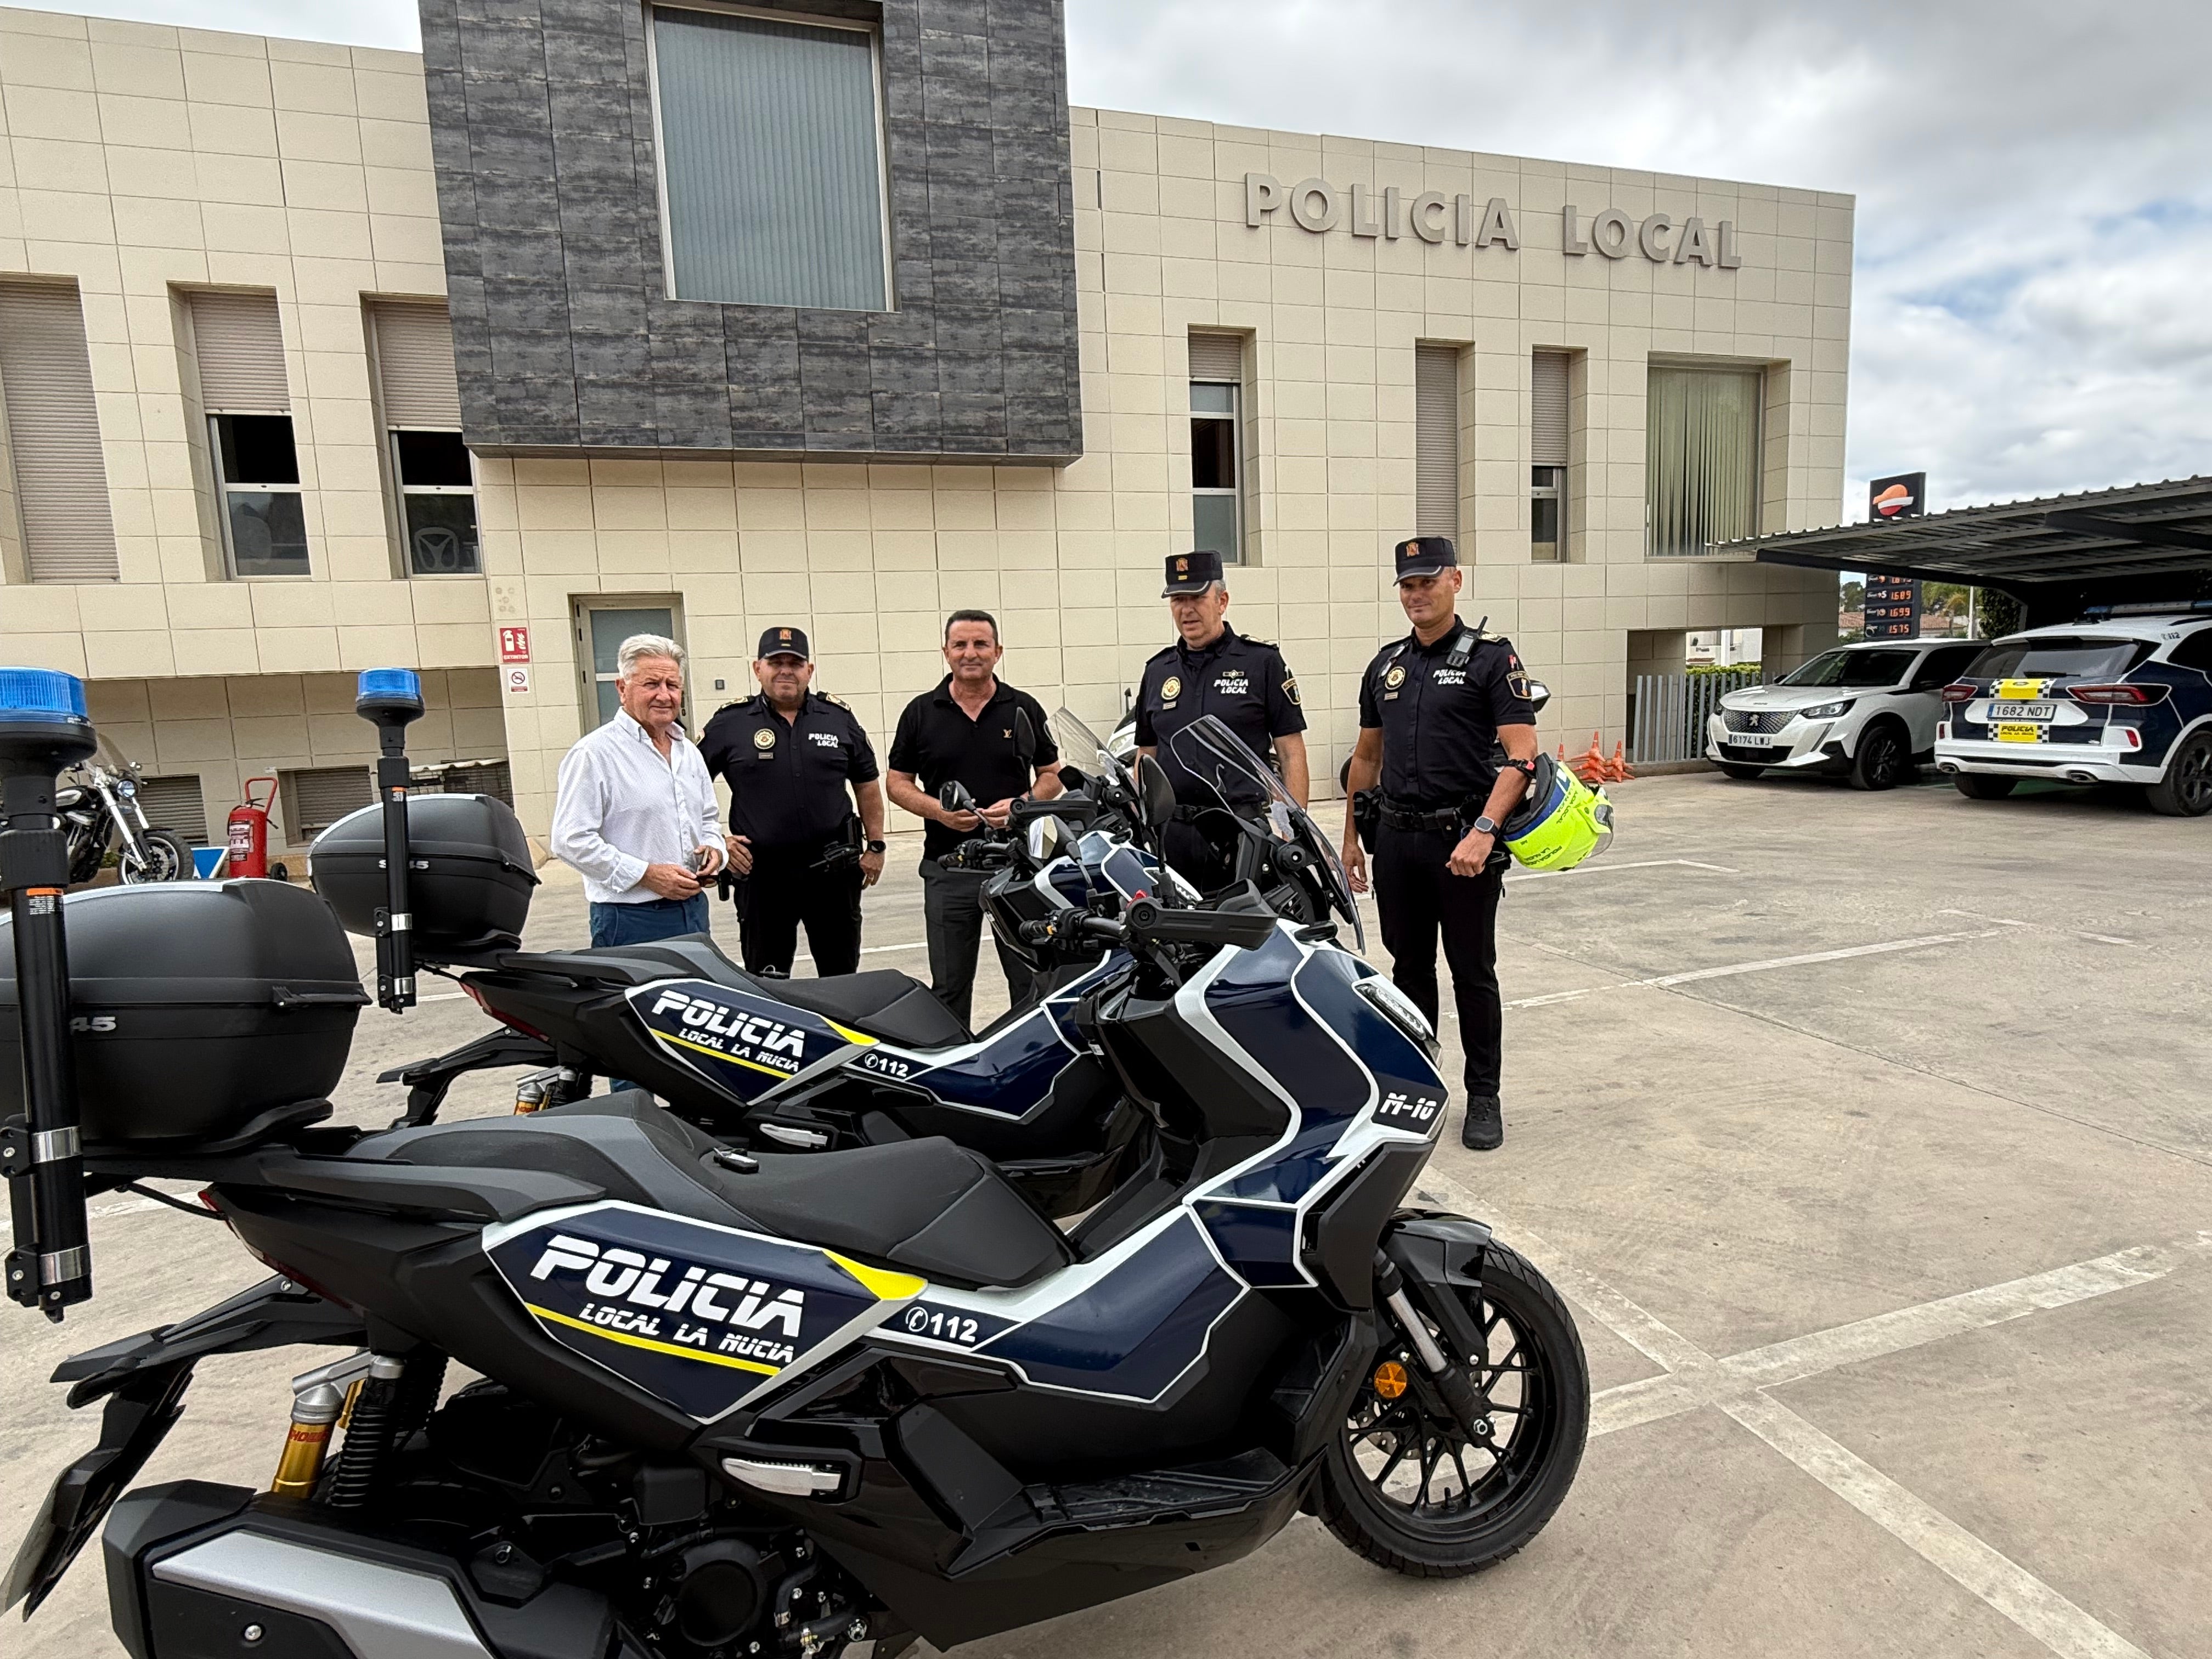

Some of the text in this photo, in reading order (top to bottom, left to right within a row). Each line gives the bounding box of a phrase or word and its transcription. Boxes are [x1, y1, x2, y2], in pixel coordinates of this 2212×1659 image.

[1245, 172, 1741, 269] POLICIA LOCAL
[1214, 679, 1249, 687] POLICIA
[1996, 706, 2051, 716] 1682 NDT
[1733, 735, 1752, 744] 6174
[651, 990, 805, 1058] POLICIA
[678, 1028, 799, 1073] LOCAL LA NUCIA
[879, 1058, 909, 1077] 112
[530, 1234, 805, 1338] POLICIA
[578, 1303, 795, 1363] LOCAL LA NUCIA
[930, 1312, 978, 1342] 112
